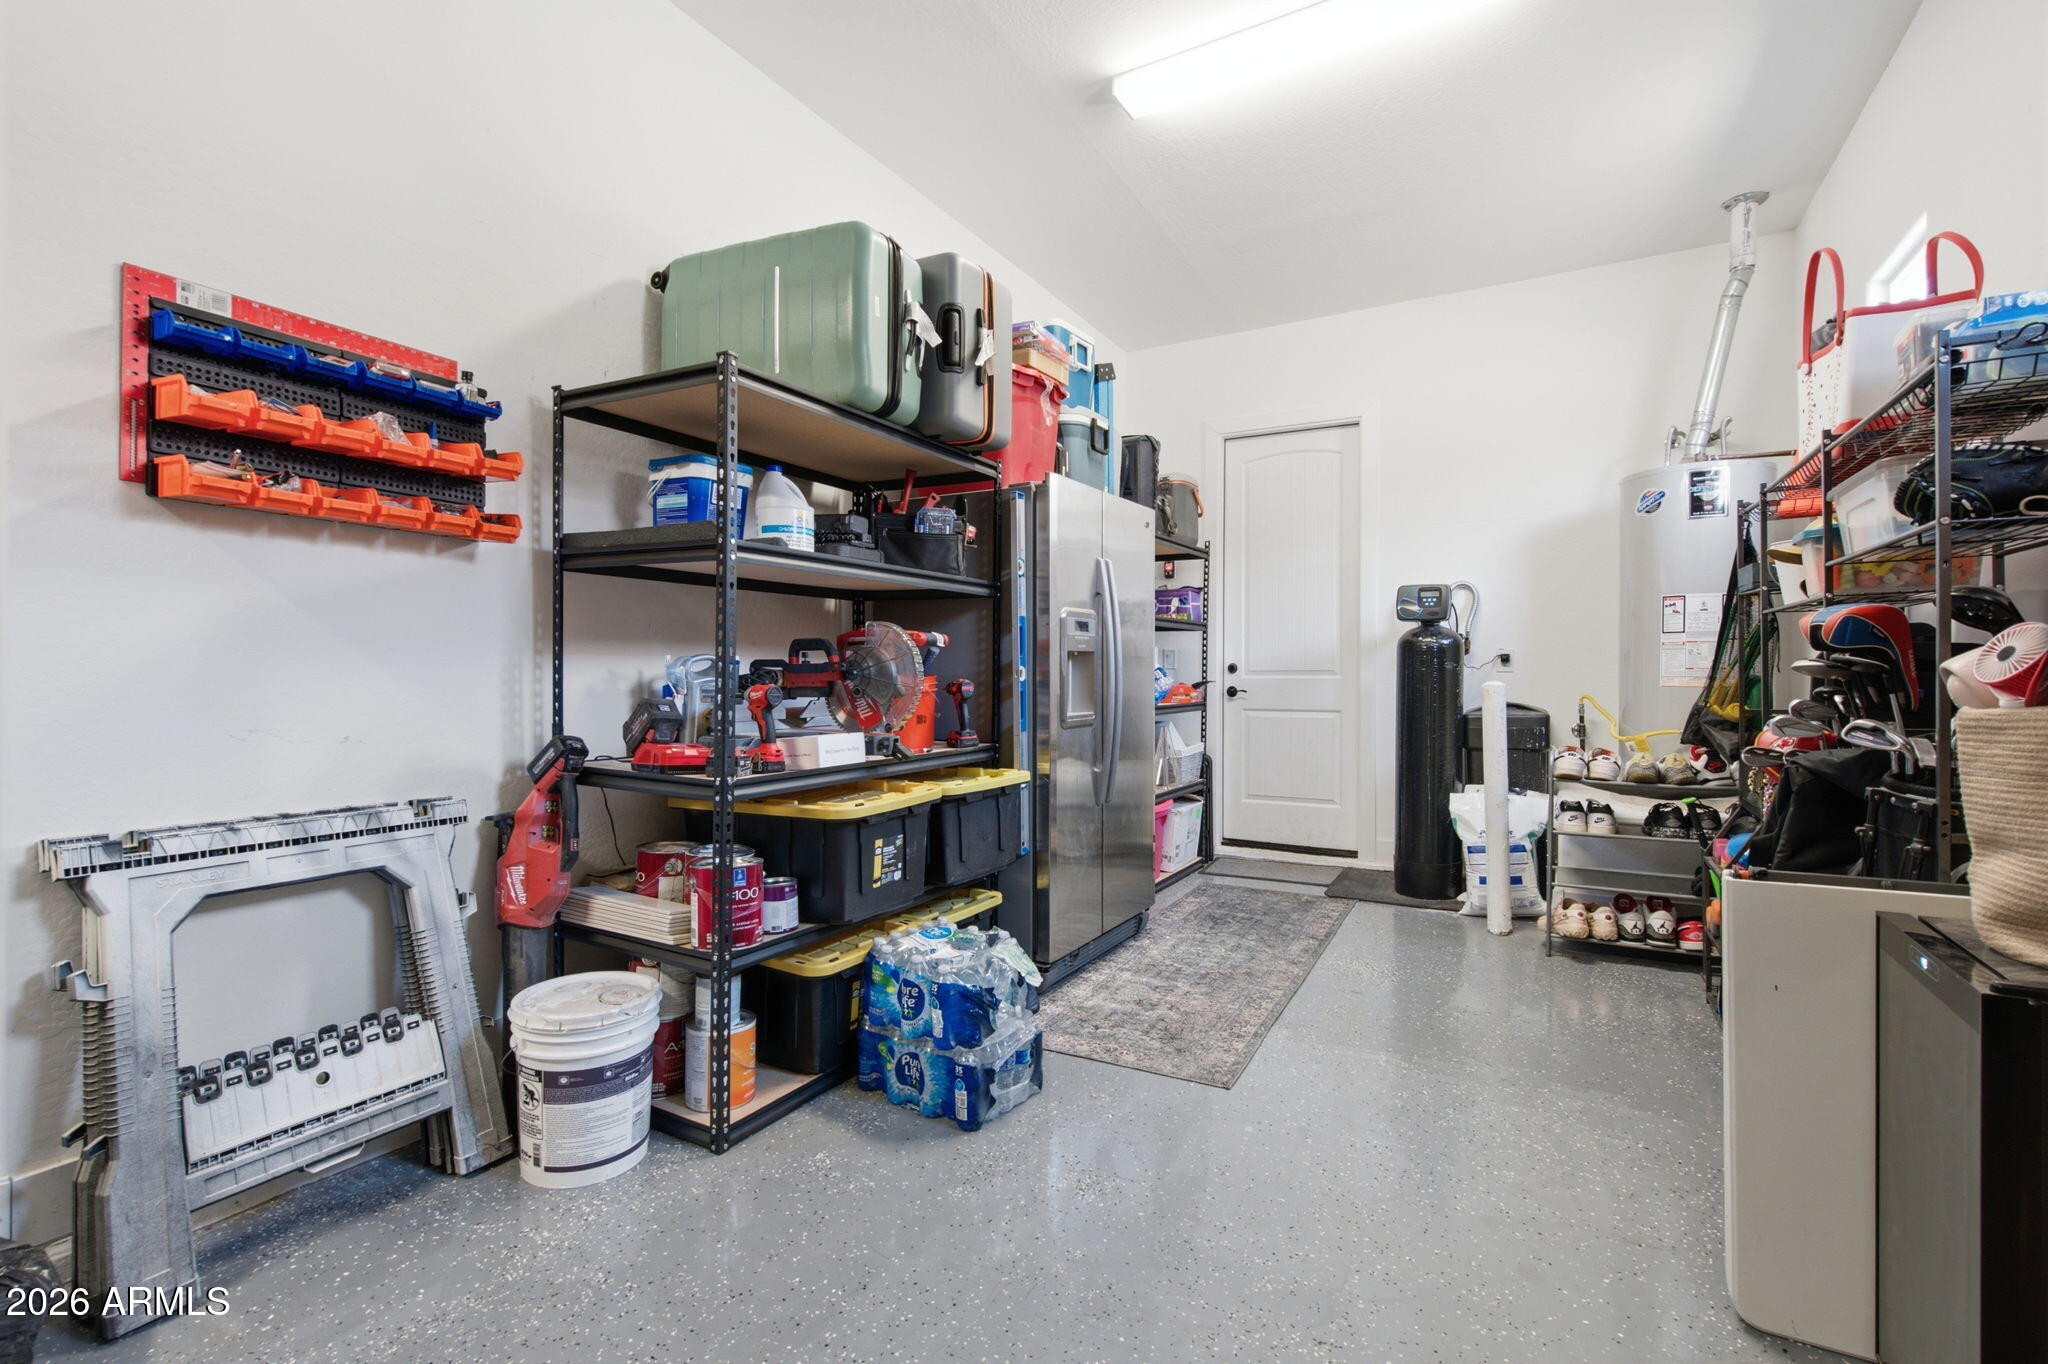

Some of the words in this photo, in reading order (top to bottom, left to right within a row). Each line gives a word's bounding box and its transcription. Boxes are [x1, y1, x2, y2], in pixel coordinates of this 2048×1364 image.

[155, 869, 225, 888] STANLEY
[508, 863, 527, 905] Milwaukee
[901, 982, 919, 997] re
[901, 1054, 920, 1072] Pur
